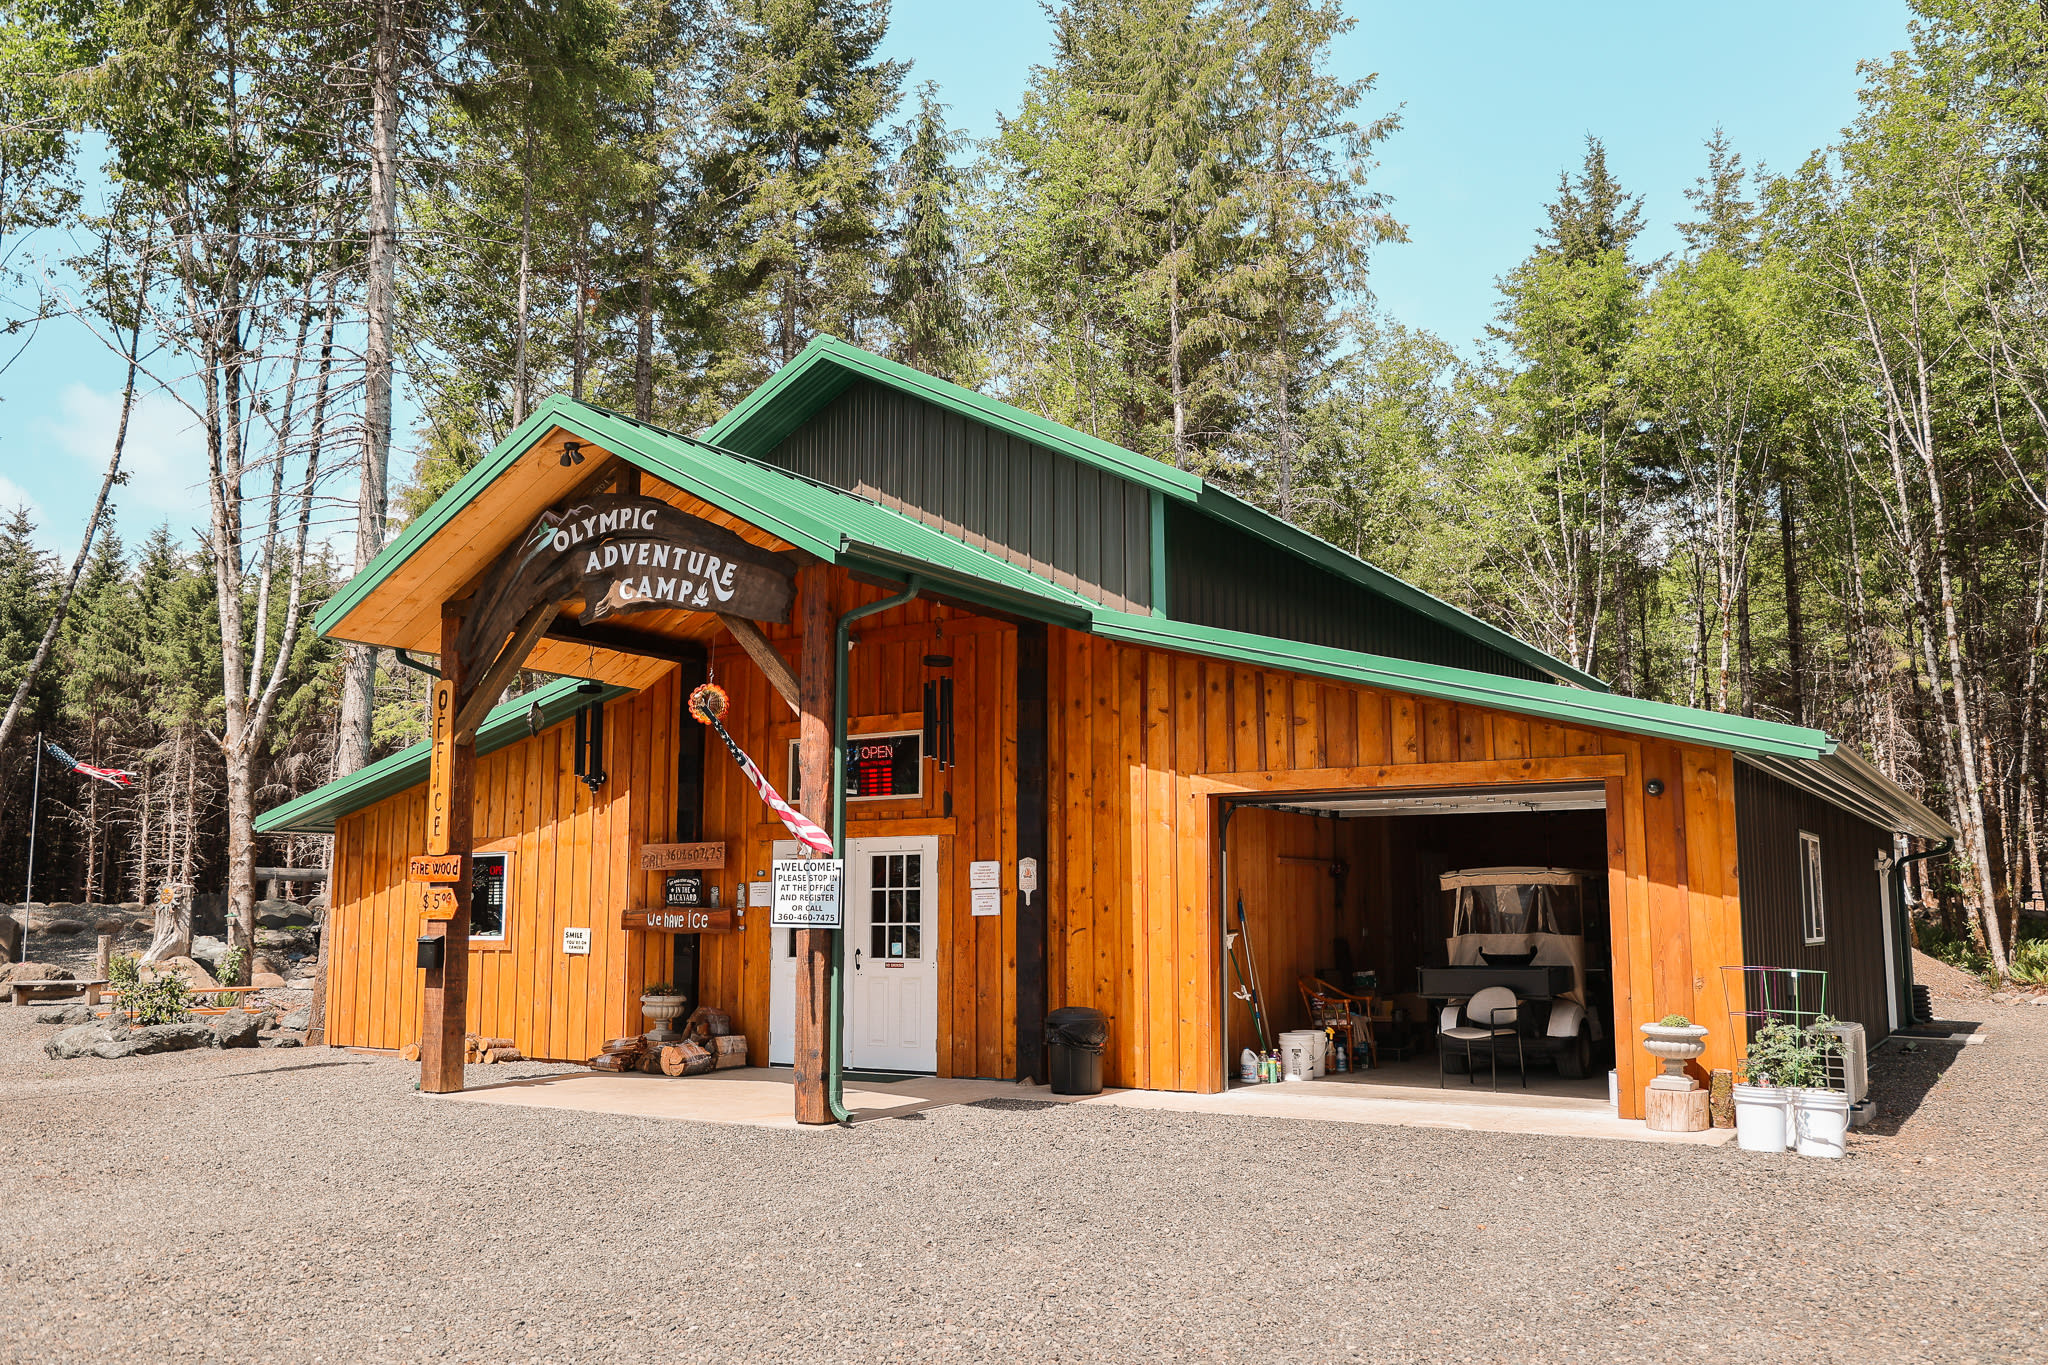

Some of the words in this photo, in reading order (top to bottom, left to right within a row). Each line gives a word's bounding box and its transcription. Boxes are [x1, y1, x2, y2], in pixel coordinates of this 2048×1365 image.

[553, 508, 657, 552] OLYMPIC
[585, 543, 738, 602] ADVENTURE
[619, 576, 694, 602] CAMP
[861, 745, 893, 759] OPEN
[433, 689, 448, 837] OFFICE
[781, 862, 835, 872] WELCOME!
[778, 874, 807, 882] PLEASE
[808, 874, 828, 882] STOP
[829, 874, 838, 882] IN
[780, 884, 790, 892] AT
[793, 884, 807, 892] THE
[809, 884, 835, 892] OFFICE
[669, 893, 698, 902] BACKYARD
[780, 894, 797, 902] AND
[799, 894, 835, 902] REGISTER
[647, 912, 662, 926] We
[778, 913, 835, 922] 360-460-7475
[565, 931, 583, 939] SMILE
